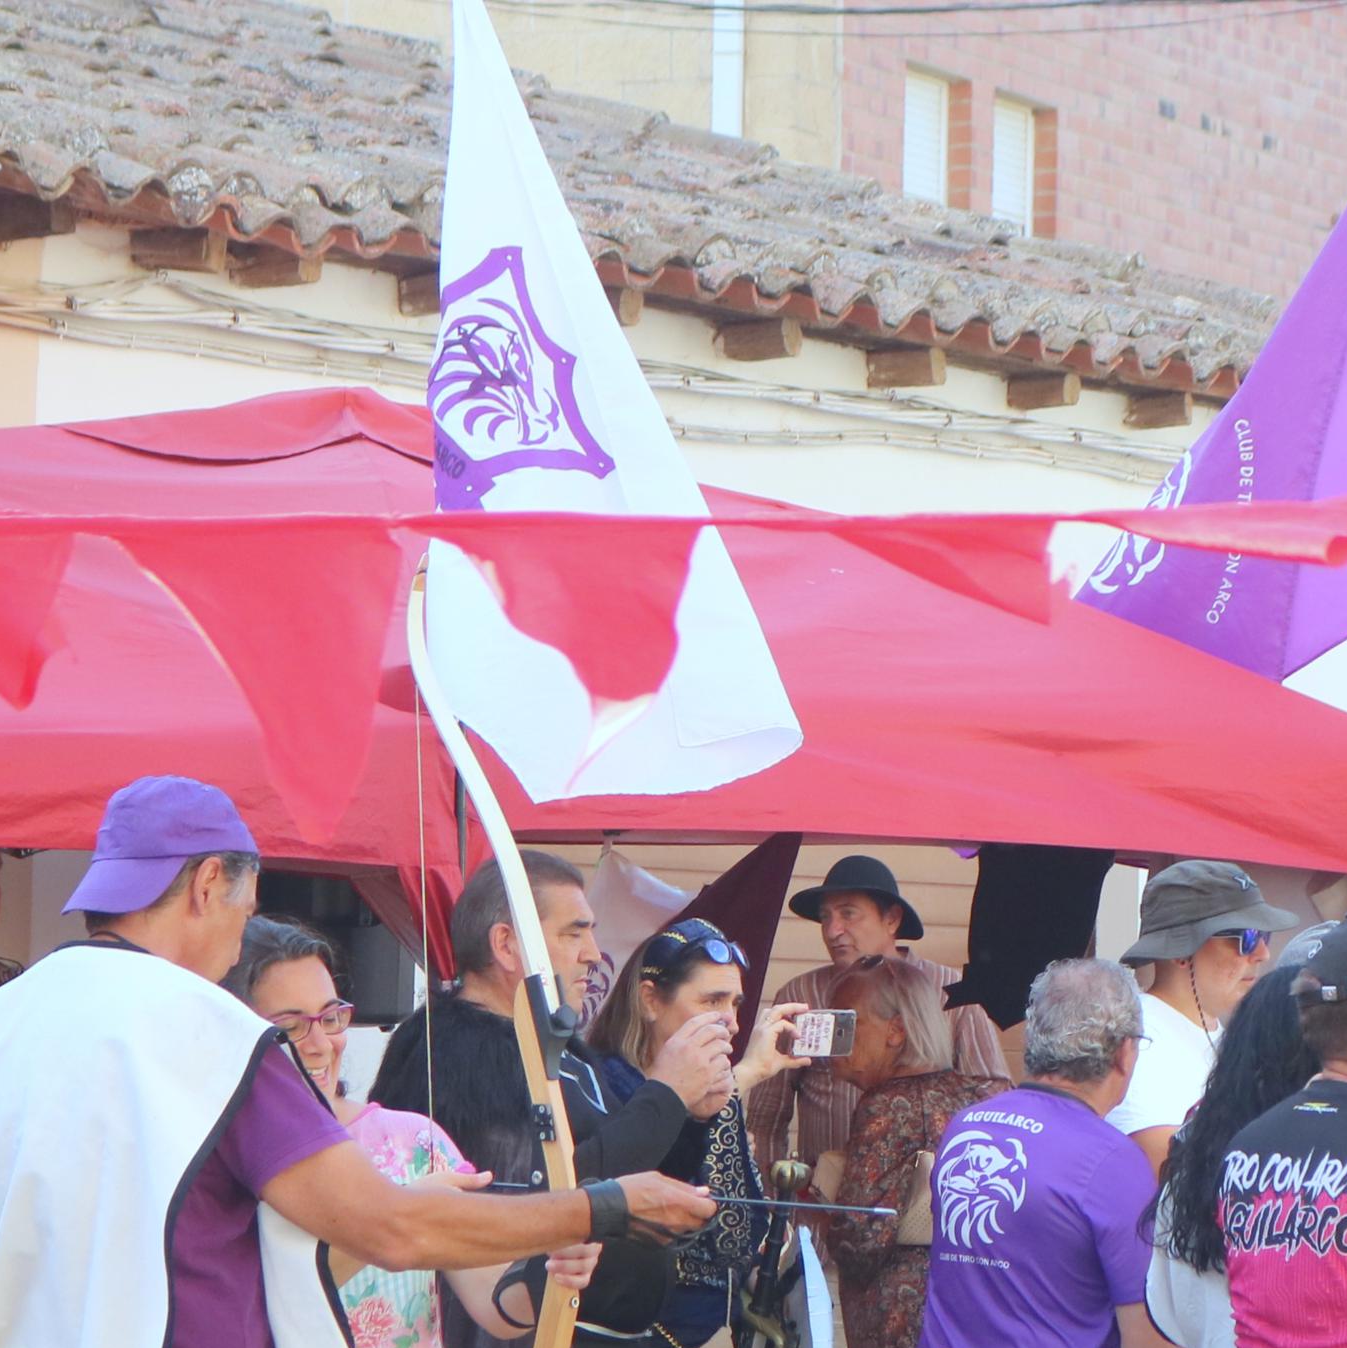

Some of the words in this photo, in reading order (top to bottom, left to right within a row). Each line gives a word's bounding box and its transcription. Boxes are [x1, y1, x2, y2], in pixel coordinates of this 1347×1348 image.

[1233, 418, 1254, 462] CLUB
[1239, 466, 1254, 487] DE
[1206, 577, 1232, 625] ARCO
[963, 1110, 1045, 1135] AGUILARCO
[1258, 1147, 1314, 1194] CON
